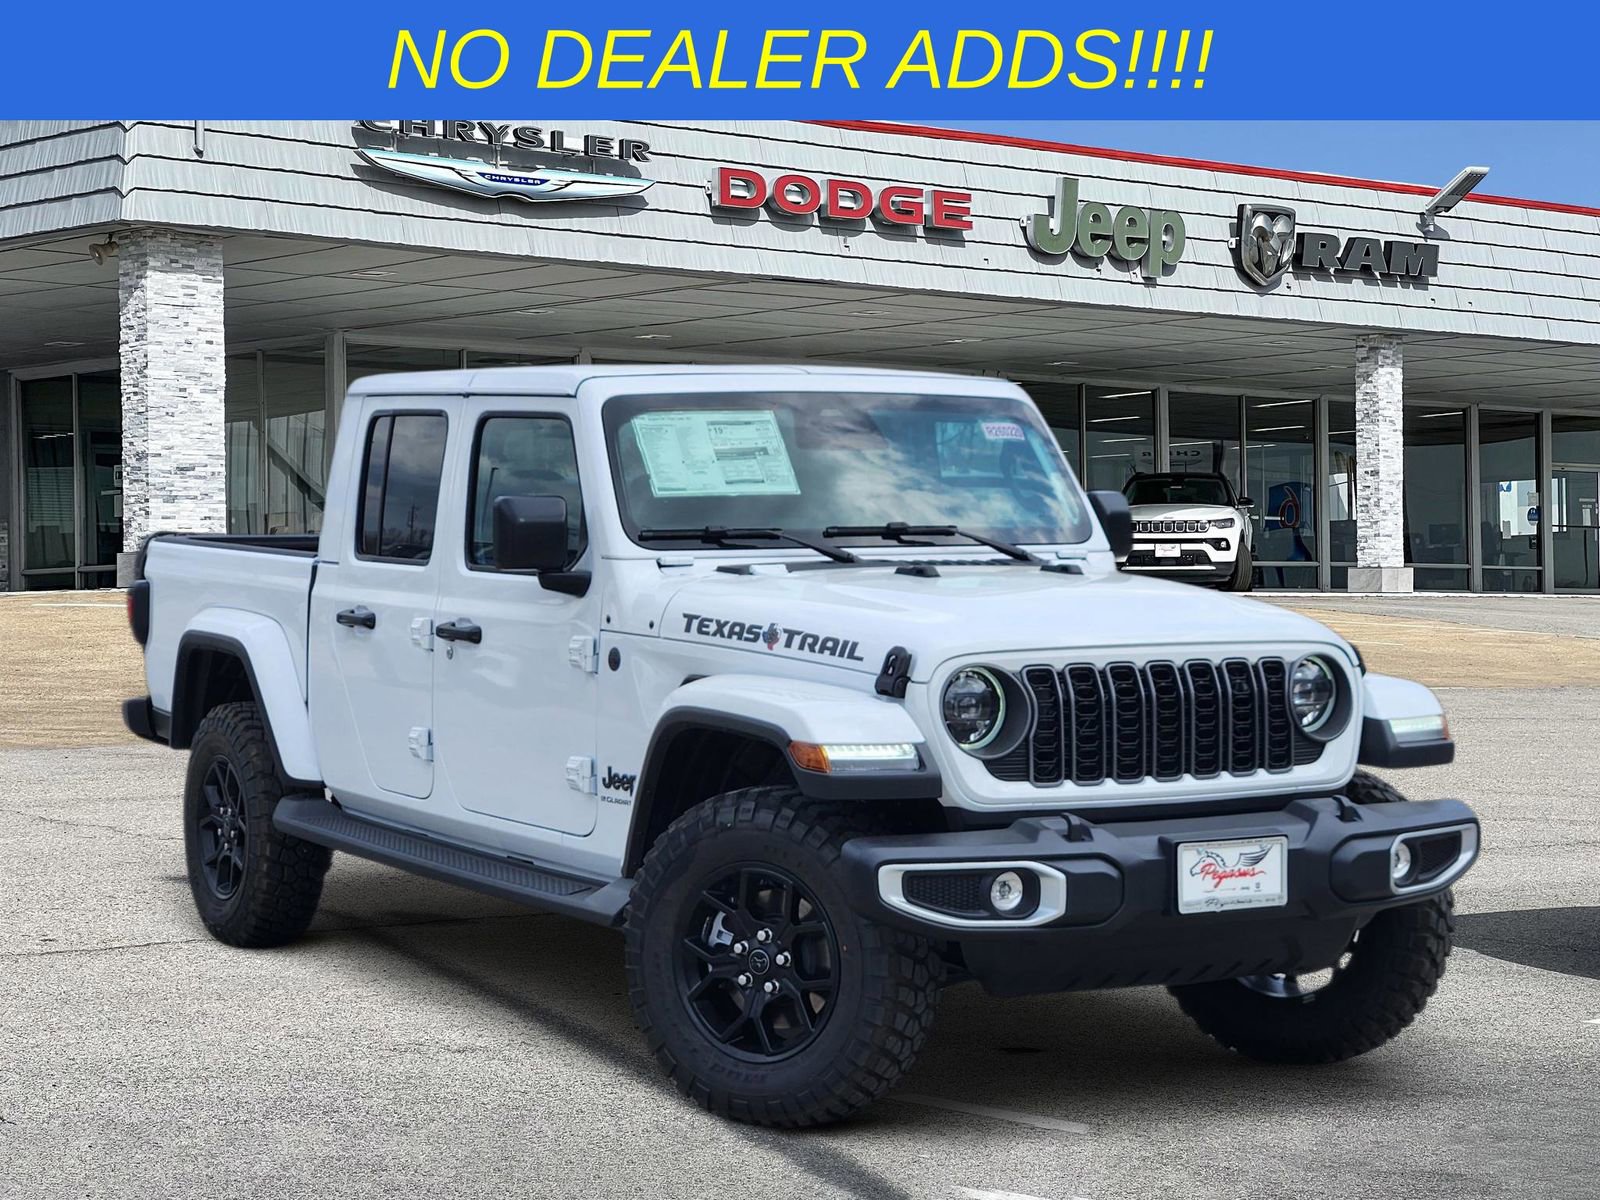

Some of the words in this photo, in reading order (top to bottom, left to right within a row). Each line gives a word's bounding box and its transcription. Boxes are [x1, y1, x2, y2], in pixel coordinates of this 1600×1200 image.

[360, 120, 650, 162] CHRYSLER
[484, 174, 542, 185] CHRYSLER
[717, 167, 972, 230] DODGE
[1026, 177, 1186, 279] Jeep
[1298, 232, 1439, 278] RAM
[683, 613, 764, 643] TEXAS
[781, 633, 864, 662] TRAIL
[602, 766, 637, 796] Jeep
[1200, 863, 1266, 889] Pegasus
